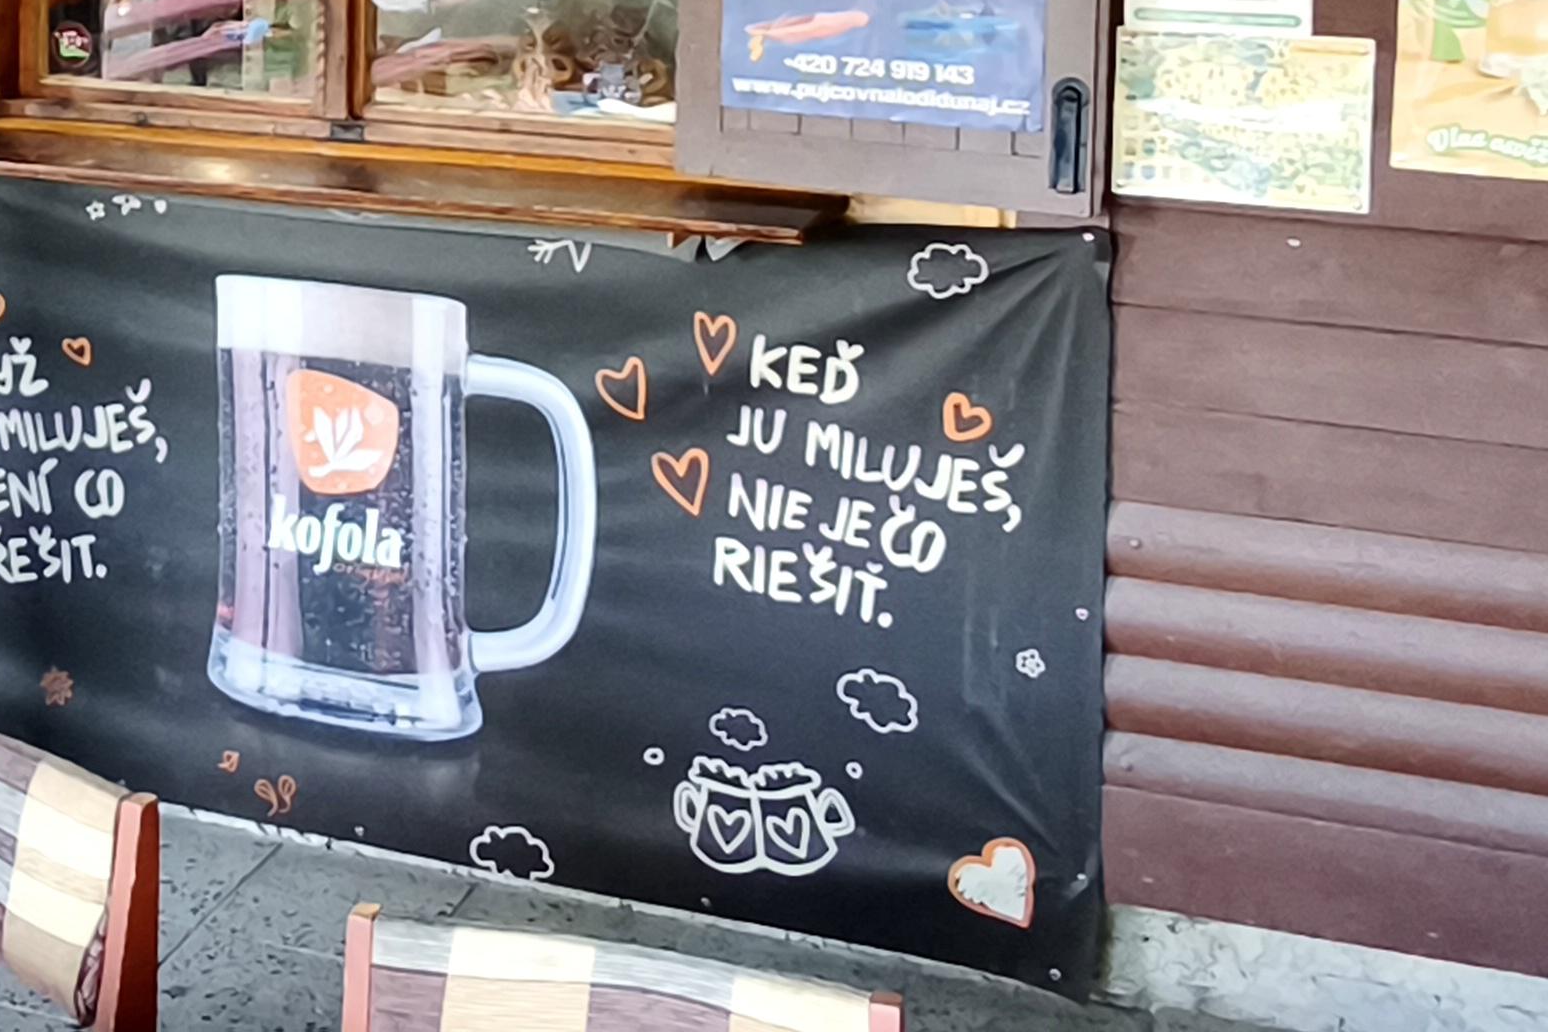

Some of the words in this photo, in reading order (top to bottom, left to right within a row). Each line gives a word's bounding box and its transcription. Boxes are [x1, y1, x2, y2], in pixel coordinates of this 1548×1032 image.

[841, 56, 886, 79] 724
[890, 58, 930, 82] 919
[934, 63, 975, 86] 143
[726, 404, 788, 455] JU
[74, 468, 125, 519] CO
[267, 493, 403, 576] kofola
[728, 472, 813, 532] NIE
[818, 496, 876, 549] JE
[879, 494, 947, 573] ČO
